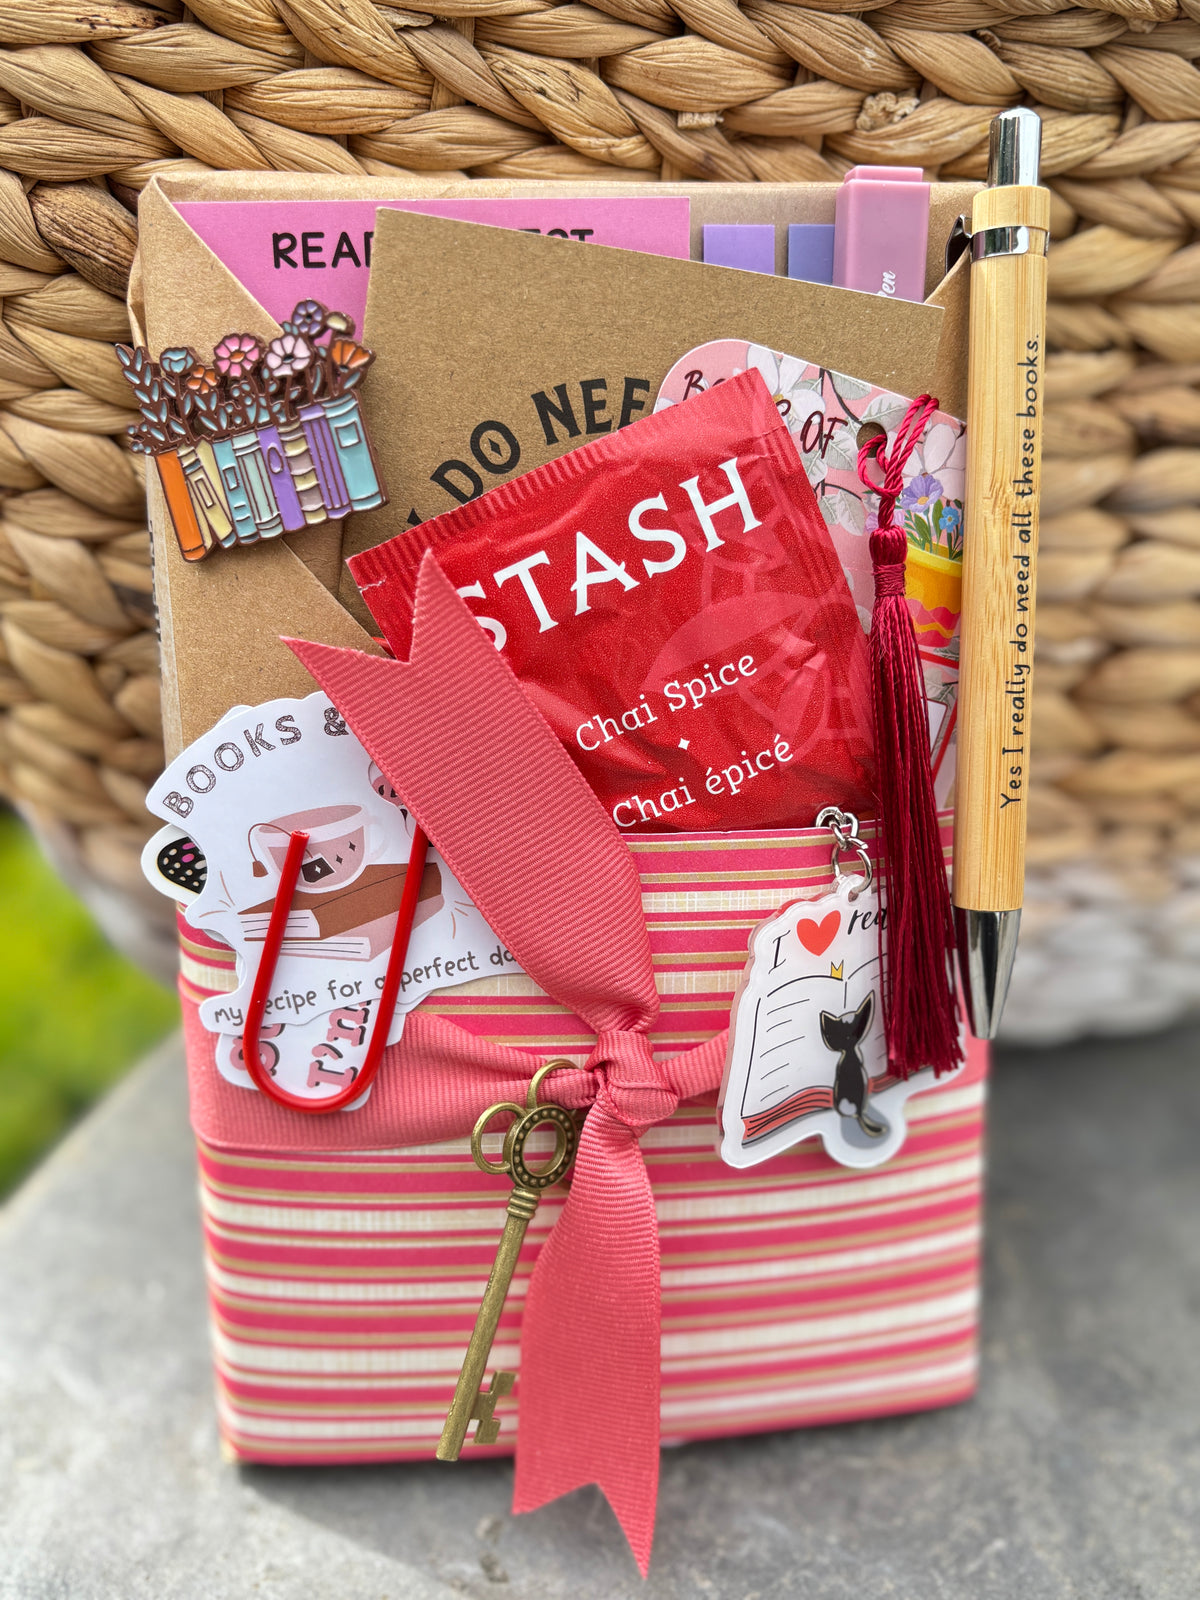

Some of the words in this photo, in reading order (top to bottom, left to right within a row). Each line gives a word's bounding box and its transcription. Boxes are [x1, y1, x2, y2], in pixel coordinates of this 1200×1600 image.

[1015, 333, 1039, 418] books.
[430, 420, 521, 504] DO
[530, 376, 650, 446] NEE
[800, 411, 848, 459] OF
[1012, 428, 1035, 499] these
[455, 456, 763, 652] STASH
[1011, 511, 1032, 544] all
[1012, 555, 1030, 612] need
[1009, 623, 1028, 652] do
[575, 692, 658, 751] Chai
[663, 654, 758, 713] Spice
[162, 714, 302, 819] BOOKS
[612, 776, 697, 829] Chai
[704, 733, 795, 796] épicé
[1001, 746, 1024, 756] I
[999, 766, 1022, 809] Yes
[768, 930, 791, 975] I
[847, 907, 888, 936] rea
[214, 1006, 244, 1026] my
[264, 989, 317, 1014] ecipe
[327, 979, 362, 1000] for
[400, 951, 479, 992] perfect
[489, 945, 516, 967] da
